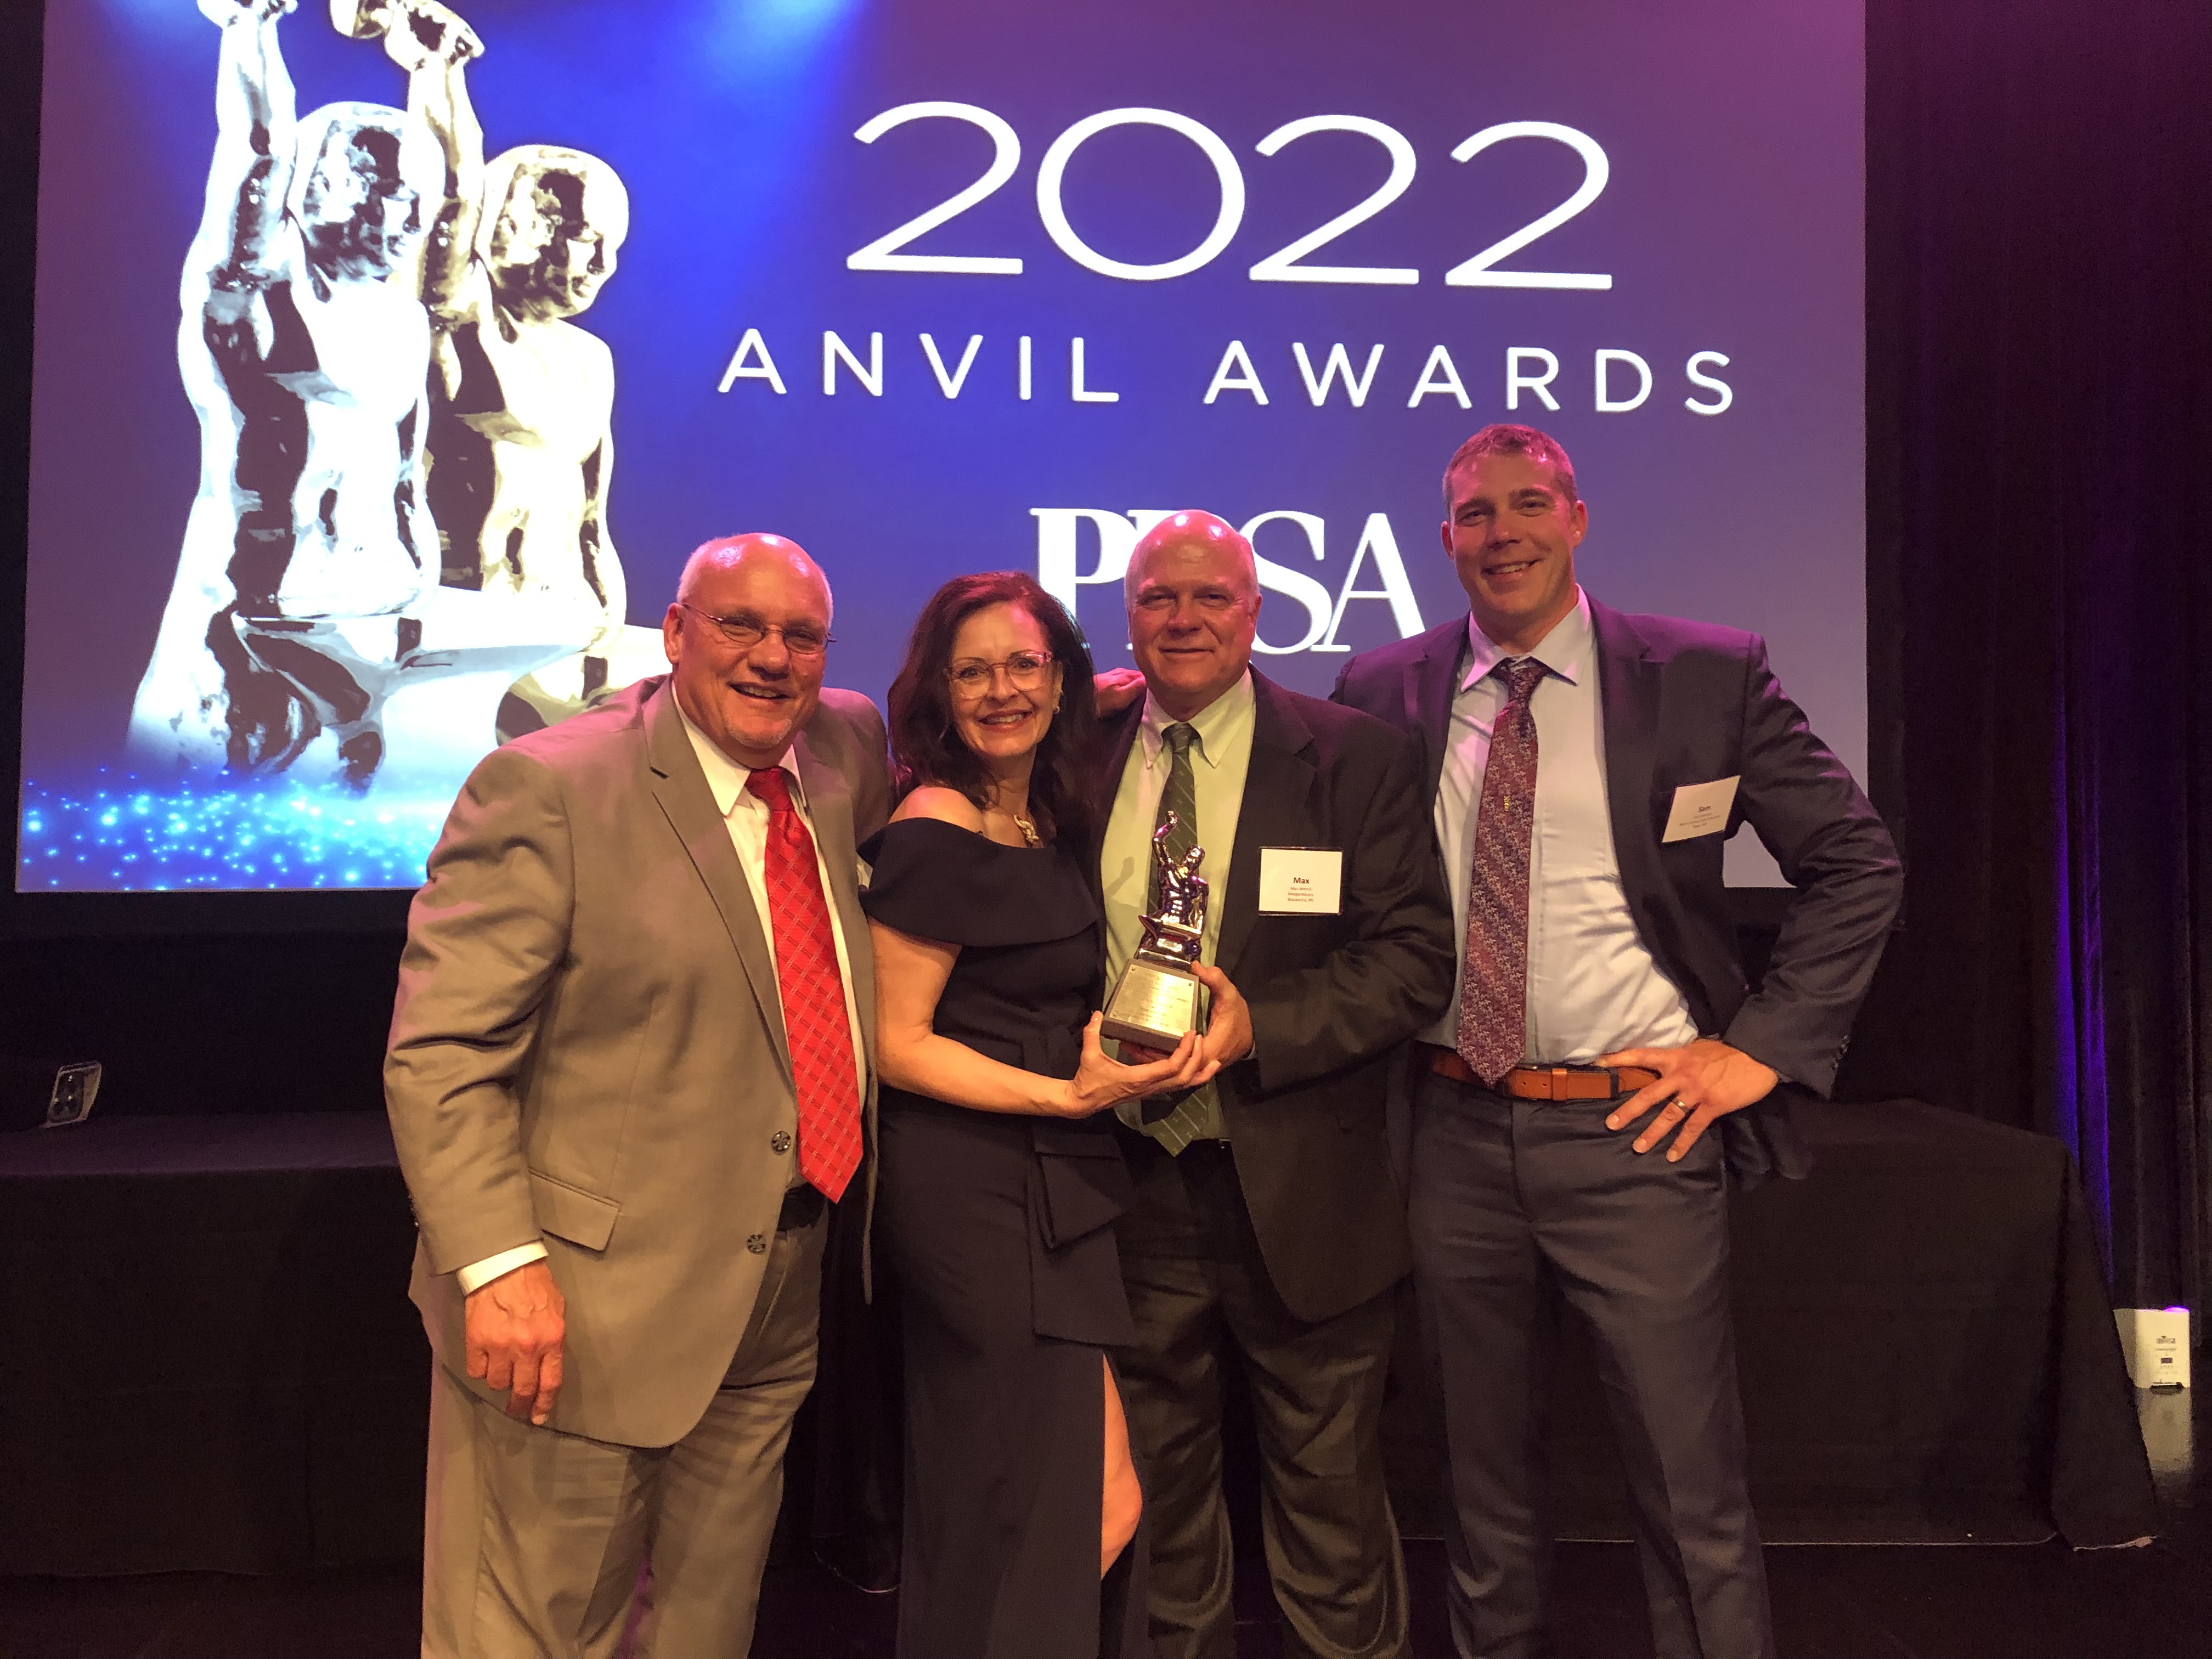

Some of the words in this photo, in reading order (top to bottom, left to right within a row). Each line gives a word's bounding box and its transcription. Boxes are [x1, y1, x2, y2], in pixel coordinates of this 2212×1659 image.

[845, 100, 1613, 290] 2022
[717, 328, 1120, 403] ANVIL
[1203, 340, 1734, 416] AWARDS
[1029, 507, 1426, 655] PSA
